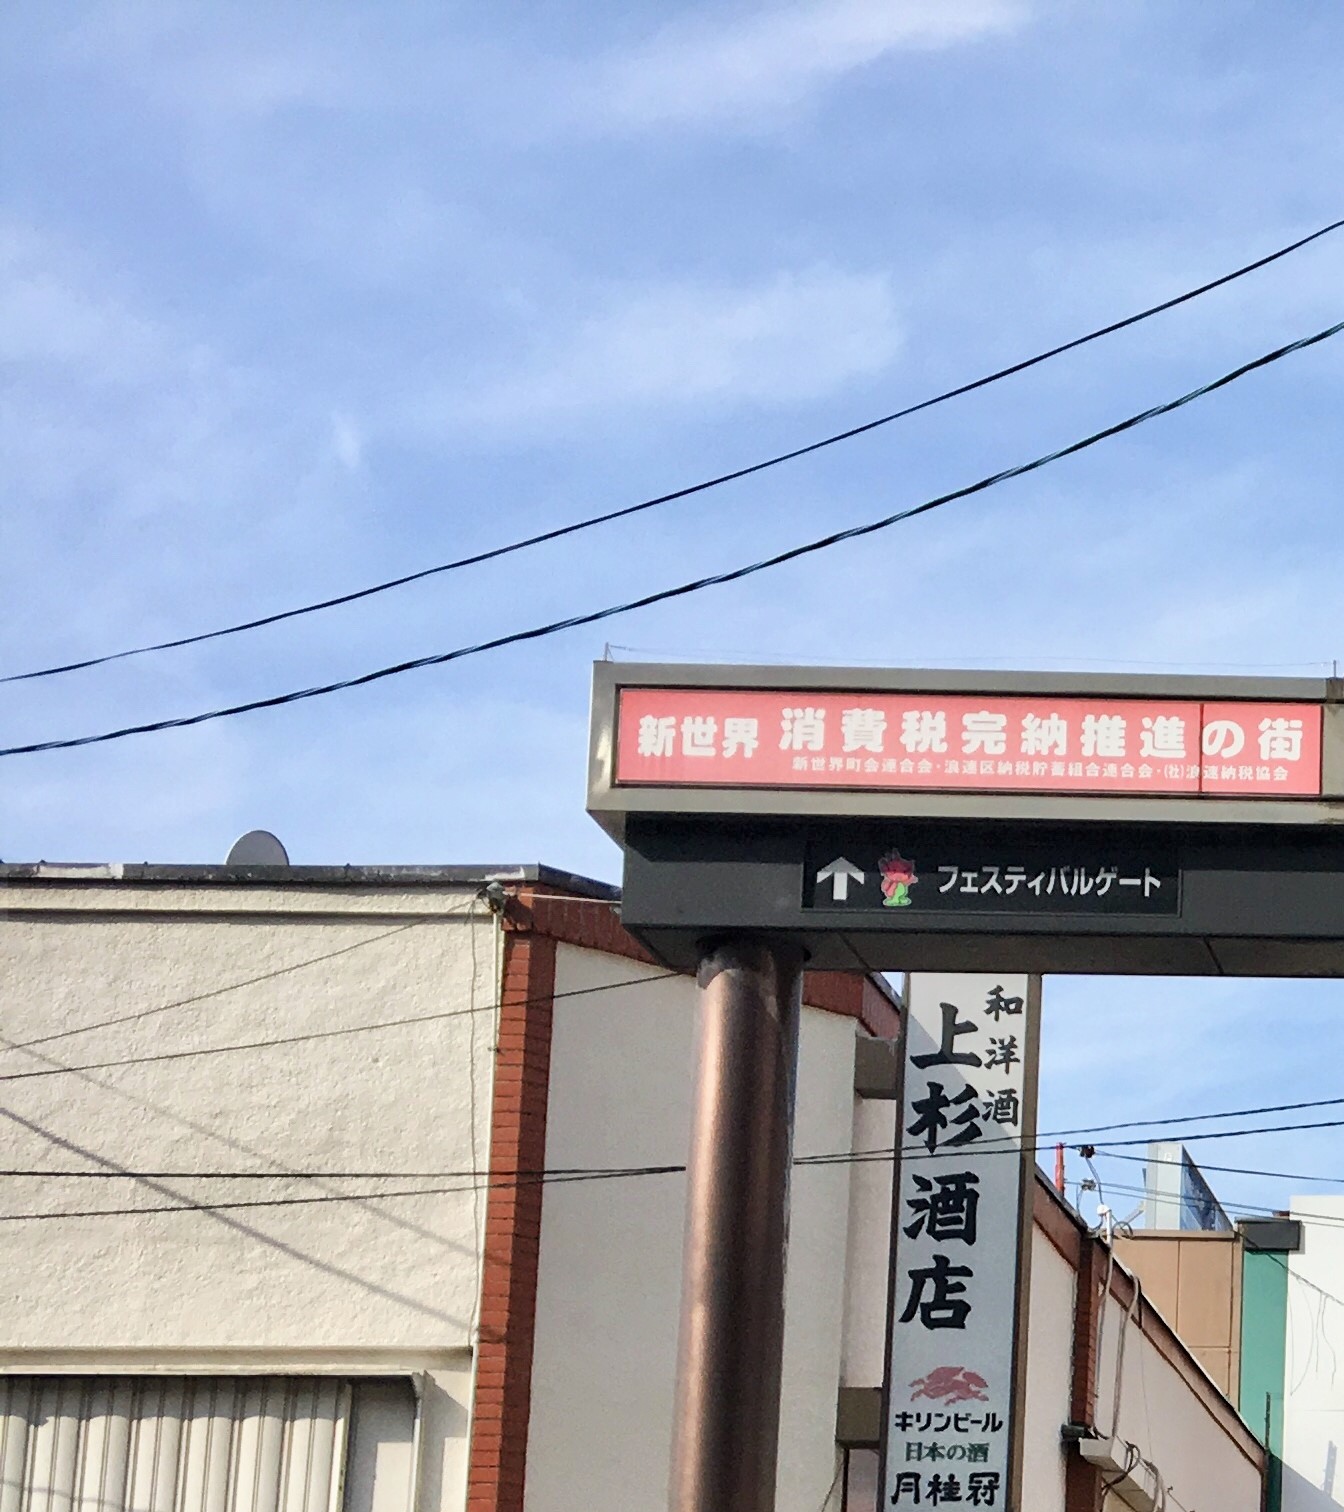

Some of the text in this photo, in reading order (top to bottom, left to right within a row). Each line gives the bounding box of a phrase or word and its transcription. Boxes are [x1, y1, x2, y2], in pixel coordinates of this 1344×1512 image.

[638, 707, 1304, 763] 新世界 消費税完納推進の街
[937, 865, 1163, 897] フェスティバルゲート
[981, 984, 1024, 1126] 和洋酒
[899, 1002, 983, 1332] 上杉酒店
[894, 1410, 1003, 1434] キリンビール
[904, 1441, 990, 1464] 日本の酒
[890, 1471, 1001, 1508] 月桂冠
